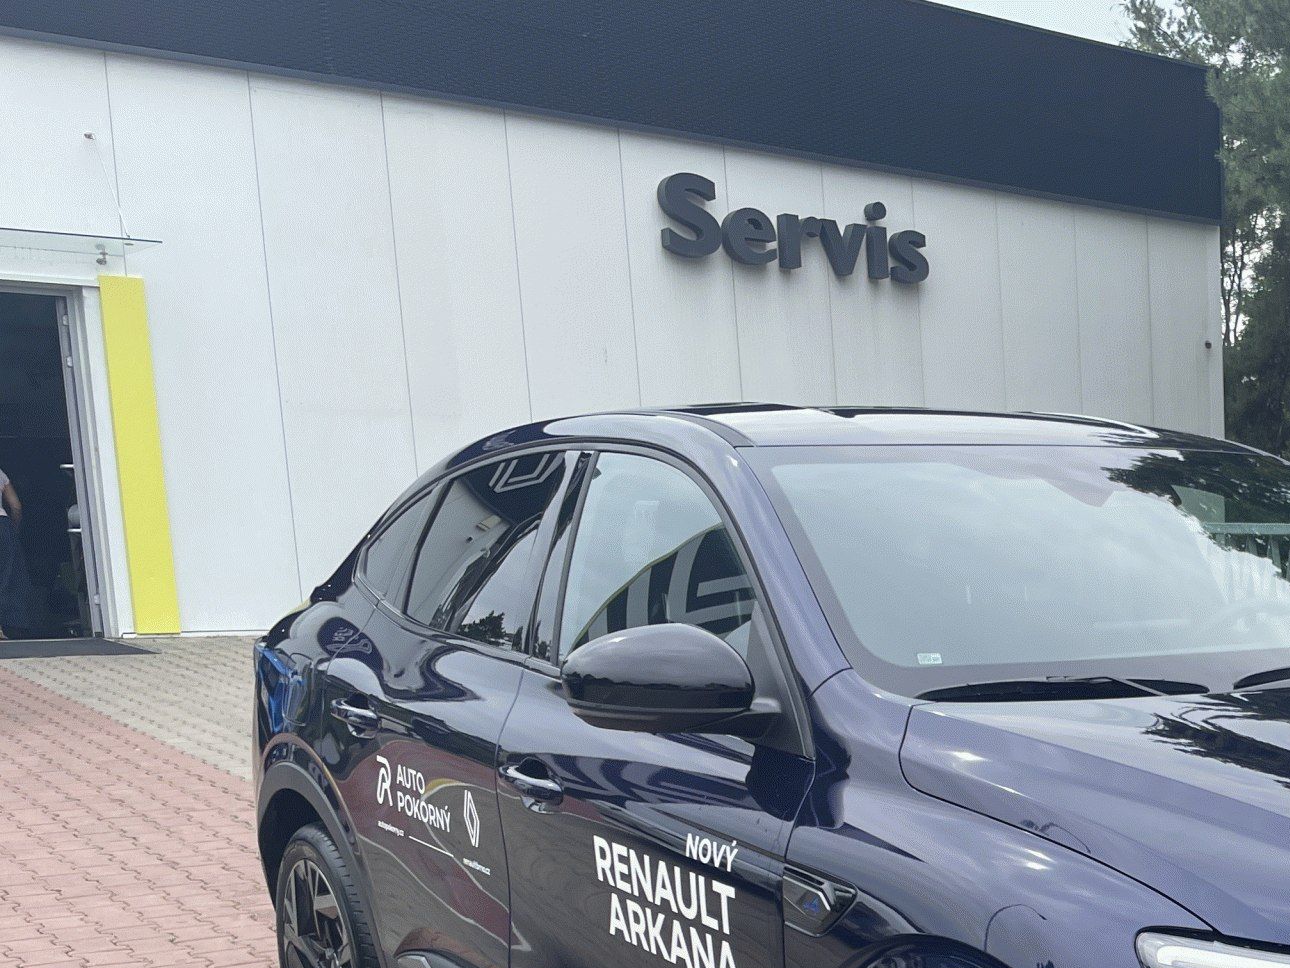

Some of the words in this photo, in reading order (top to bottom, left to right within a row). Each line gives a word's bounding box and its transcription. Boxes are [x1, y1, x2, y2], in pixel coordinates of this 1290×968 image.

[657, 172, 930, 283] Servis
[396, 764, 426, 795] AUTO
[396, 790, 451, 833] POKORNÝ
[685, 833, 739, 872] NOVÝ
[593, 835, 736, 935] RENAULT
